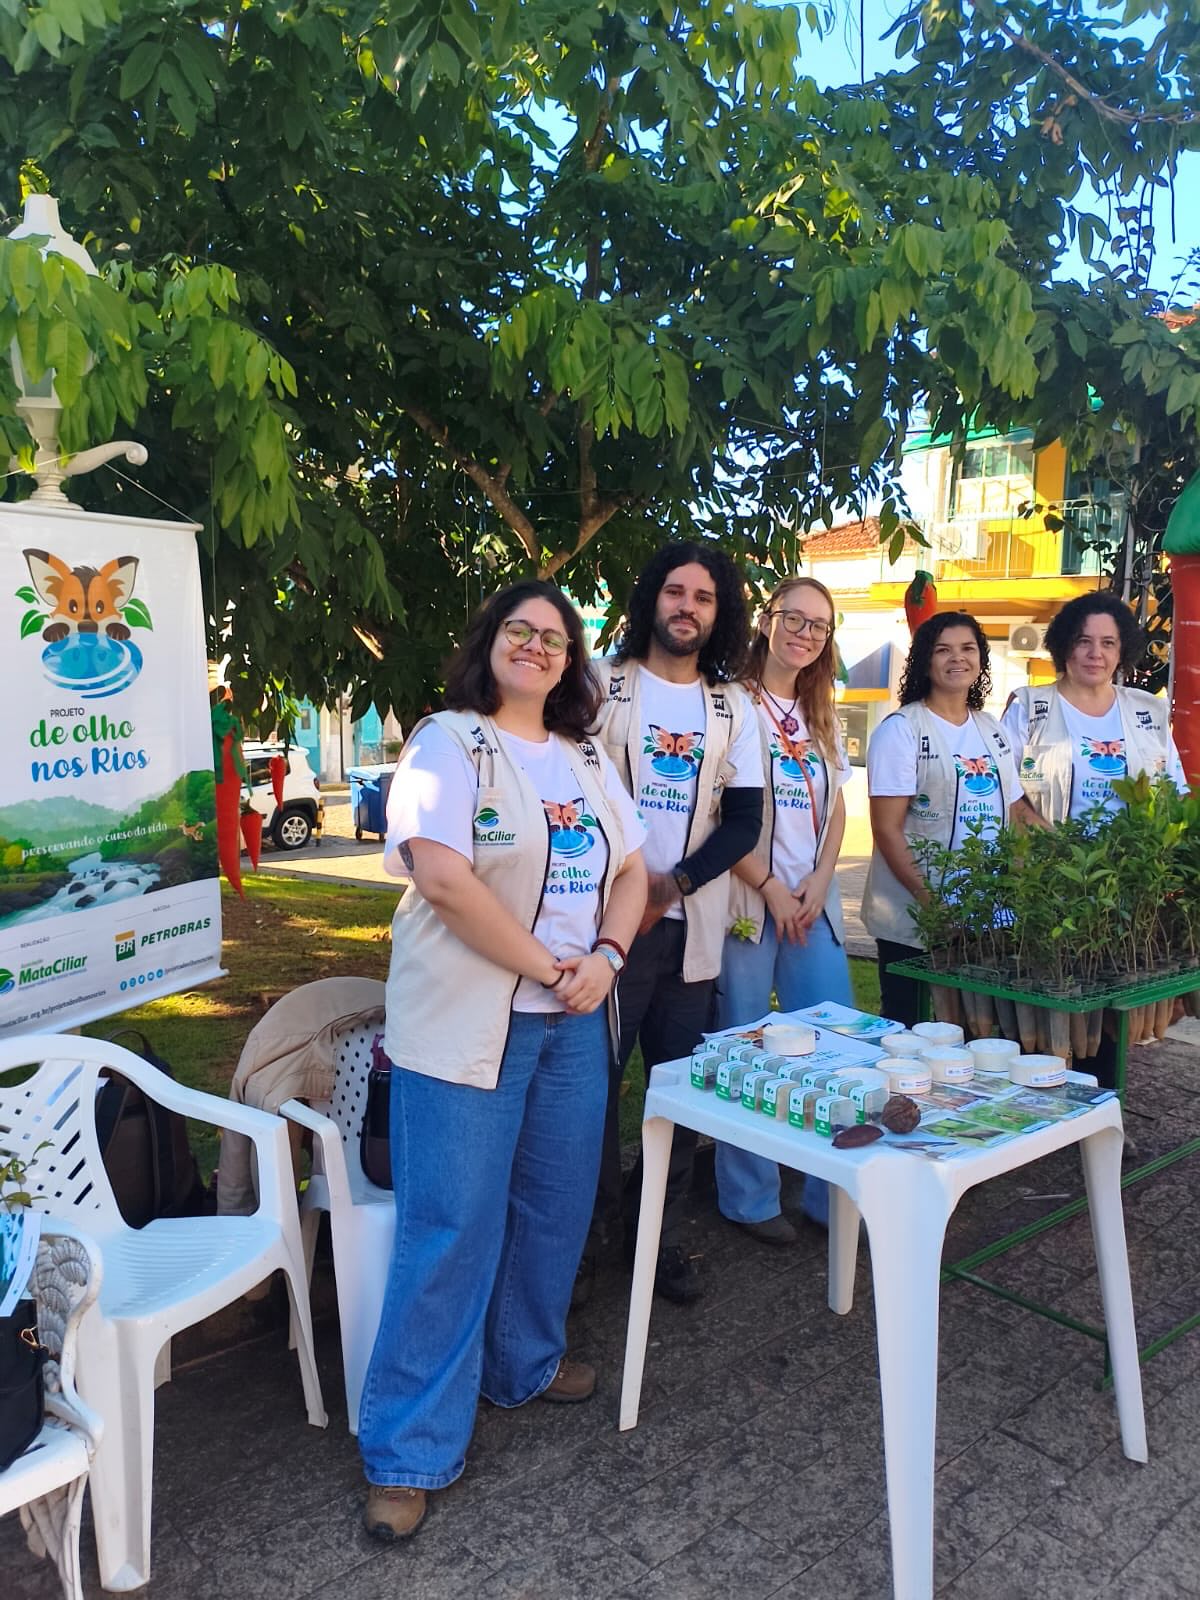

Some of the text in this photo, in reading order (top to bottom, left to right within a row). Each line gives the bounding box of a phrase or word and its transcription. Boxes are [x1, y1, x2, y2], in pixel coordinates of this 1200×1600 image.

[50, 708, 85, 717] PROJETO
[30, 714, 135, 747] de olho
[31, 746, 150, 782] nos Rios
[642, 784, 689, 800] de olho
[640, 798, 664, 809] nos
[22, 822, 168, 861] preservando o curso da vida
[562, 866, 592, 878] olho
[569, 880, 598, 894] Rio
[141, 918, 211, 947] PETROBRAS
[18, 955, 88, 985] MataCiliar
